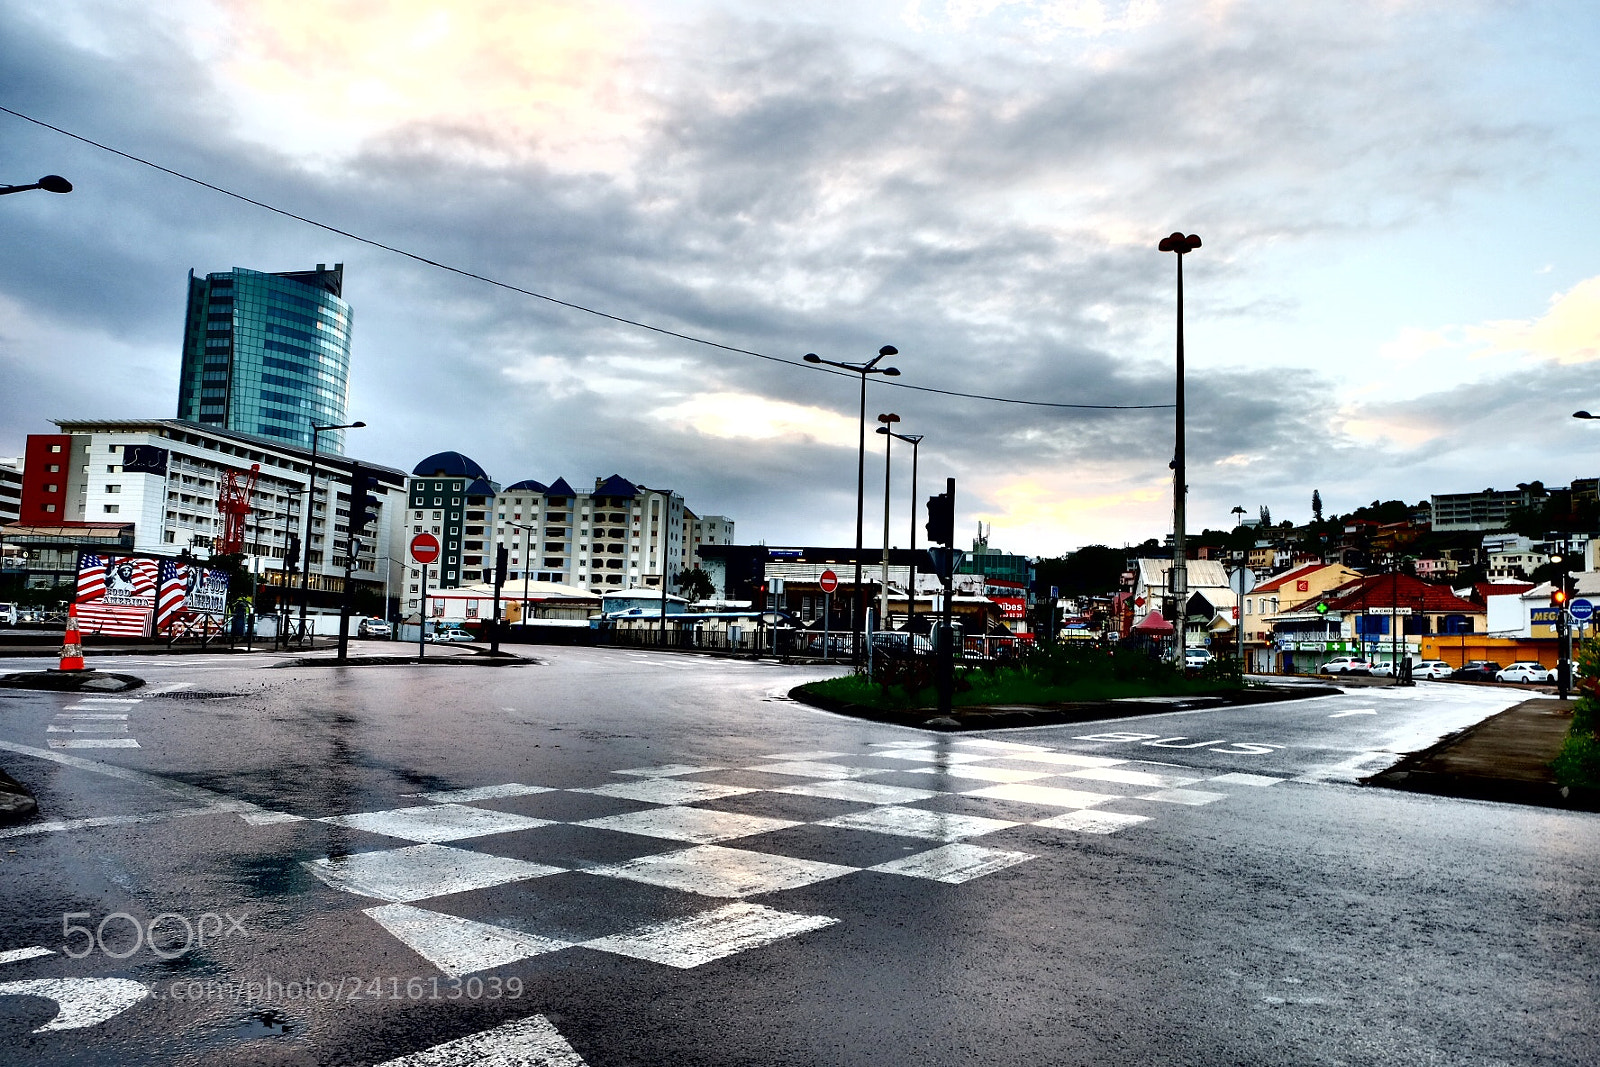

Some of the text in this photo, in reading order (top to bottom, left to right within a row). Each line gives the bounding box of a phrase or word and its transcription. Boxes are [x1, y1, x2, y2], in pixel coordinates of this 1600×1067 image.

[106, 587, 131, 597] FOOD
[206, 577, 226, 594] FOOD
[102, 597, 149, 605] AMERICA
[189, 593, 223, 611] AMERICA
[1071, 731, 1286, 754] BUS
